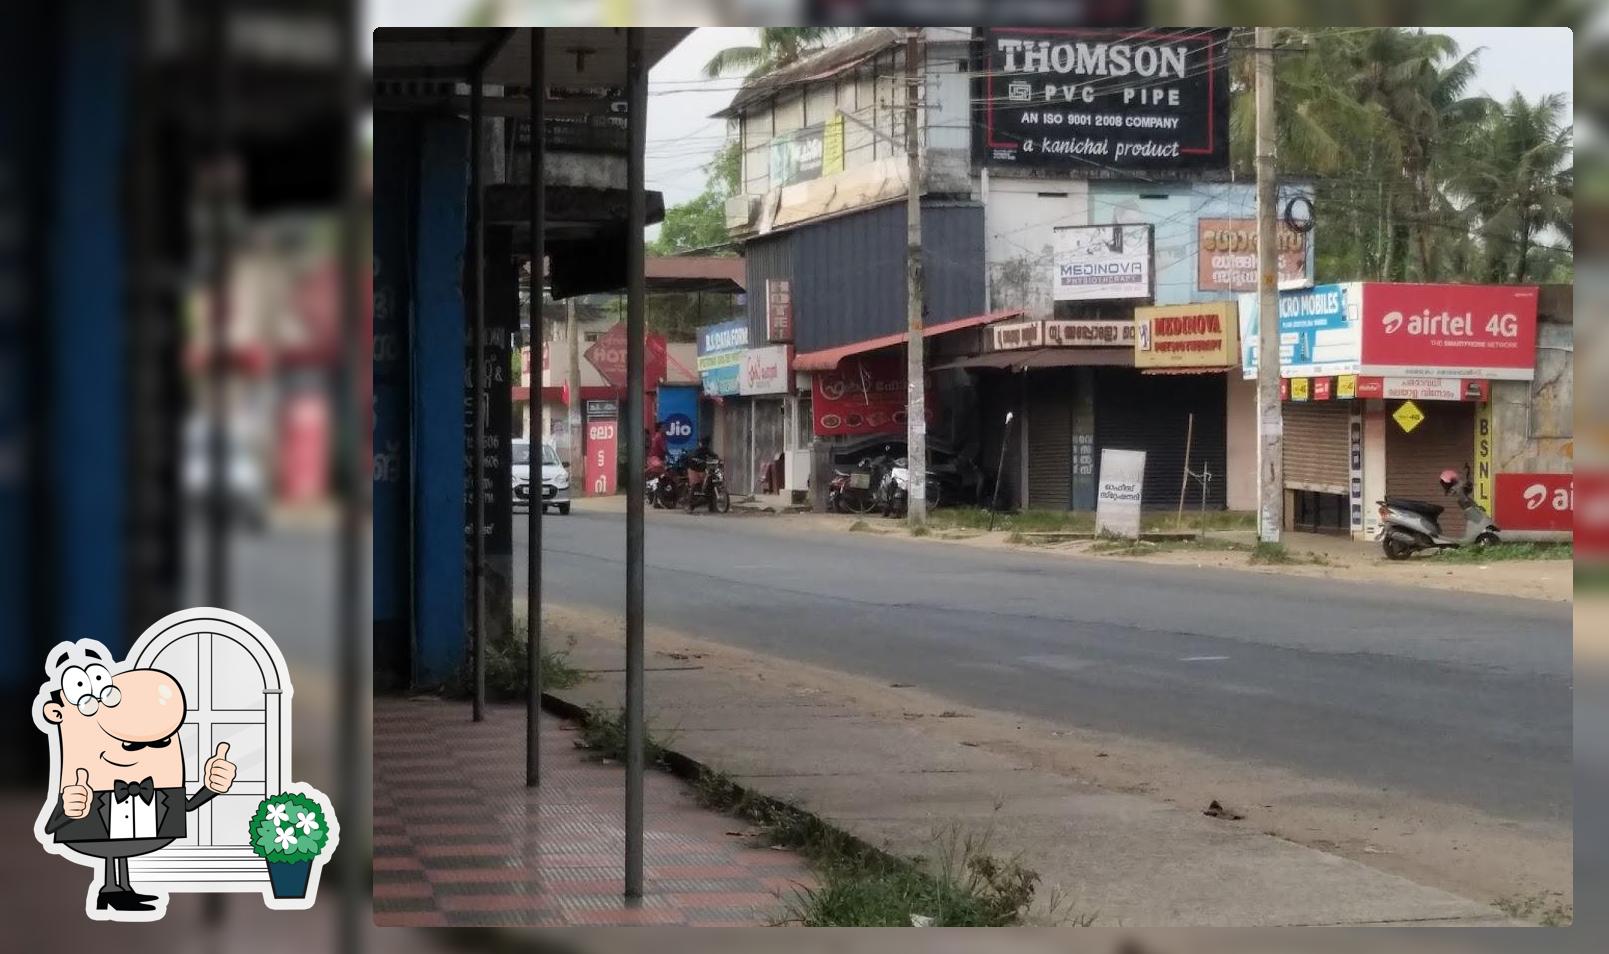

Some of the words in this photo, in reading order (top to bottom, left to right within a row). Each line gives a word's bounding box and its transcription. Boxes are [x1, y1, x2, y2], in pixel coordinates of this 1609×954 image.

[998, 39, 1187, 78] THOMSON
[1045, 85, 1095, 103] PVC
[1123, 88, 1180, 106] PIPE
[1021, 113, 1038, 124] AN
[1043, 113, 1063, 125] ISO
[1068, 114, 1091, 126] 9001
[1095, 116, 1122, 127] 2008
[1125, 117, 1179, 129] COMPANY
[1023, 140, 1033, 152] a
[1042, 137, 1109, 156] kanichal
[1115, 140, 1180, 162] product
[1060, 262, 1142, 276] MEDINOVA
[1280, 297, 1300, 318] ICRO
[1302, 292, 1339, 316] MOBILES
[1154, 314, 1222, 336] MEDINOVA
[1407, 309, 1473, 336] airtel
[1485, 313, 1518, 337] 4G
[666, 421, 691, 436] Jio
[1479, 418, 1489, 500] BSNL
